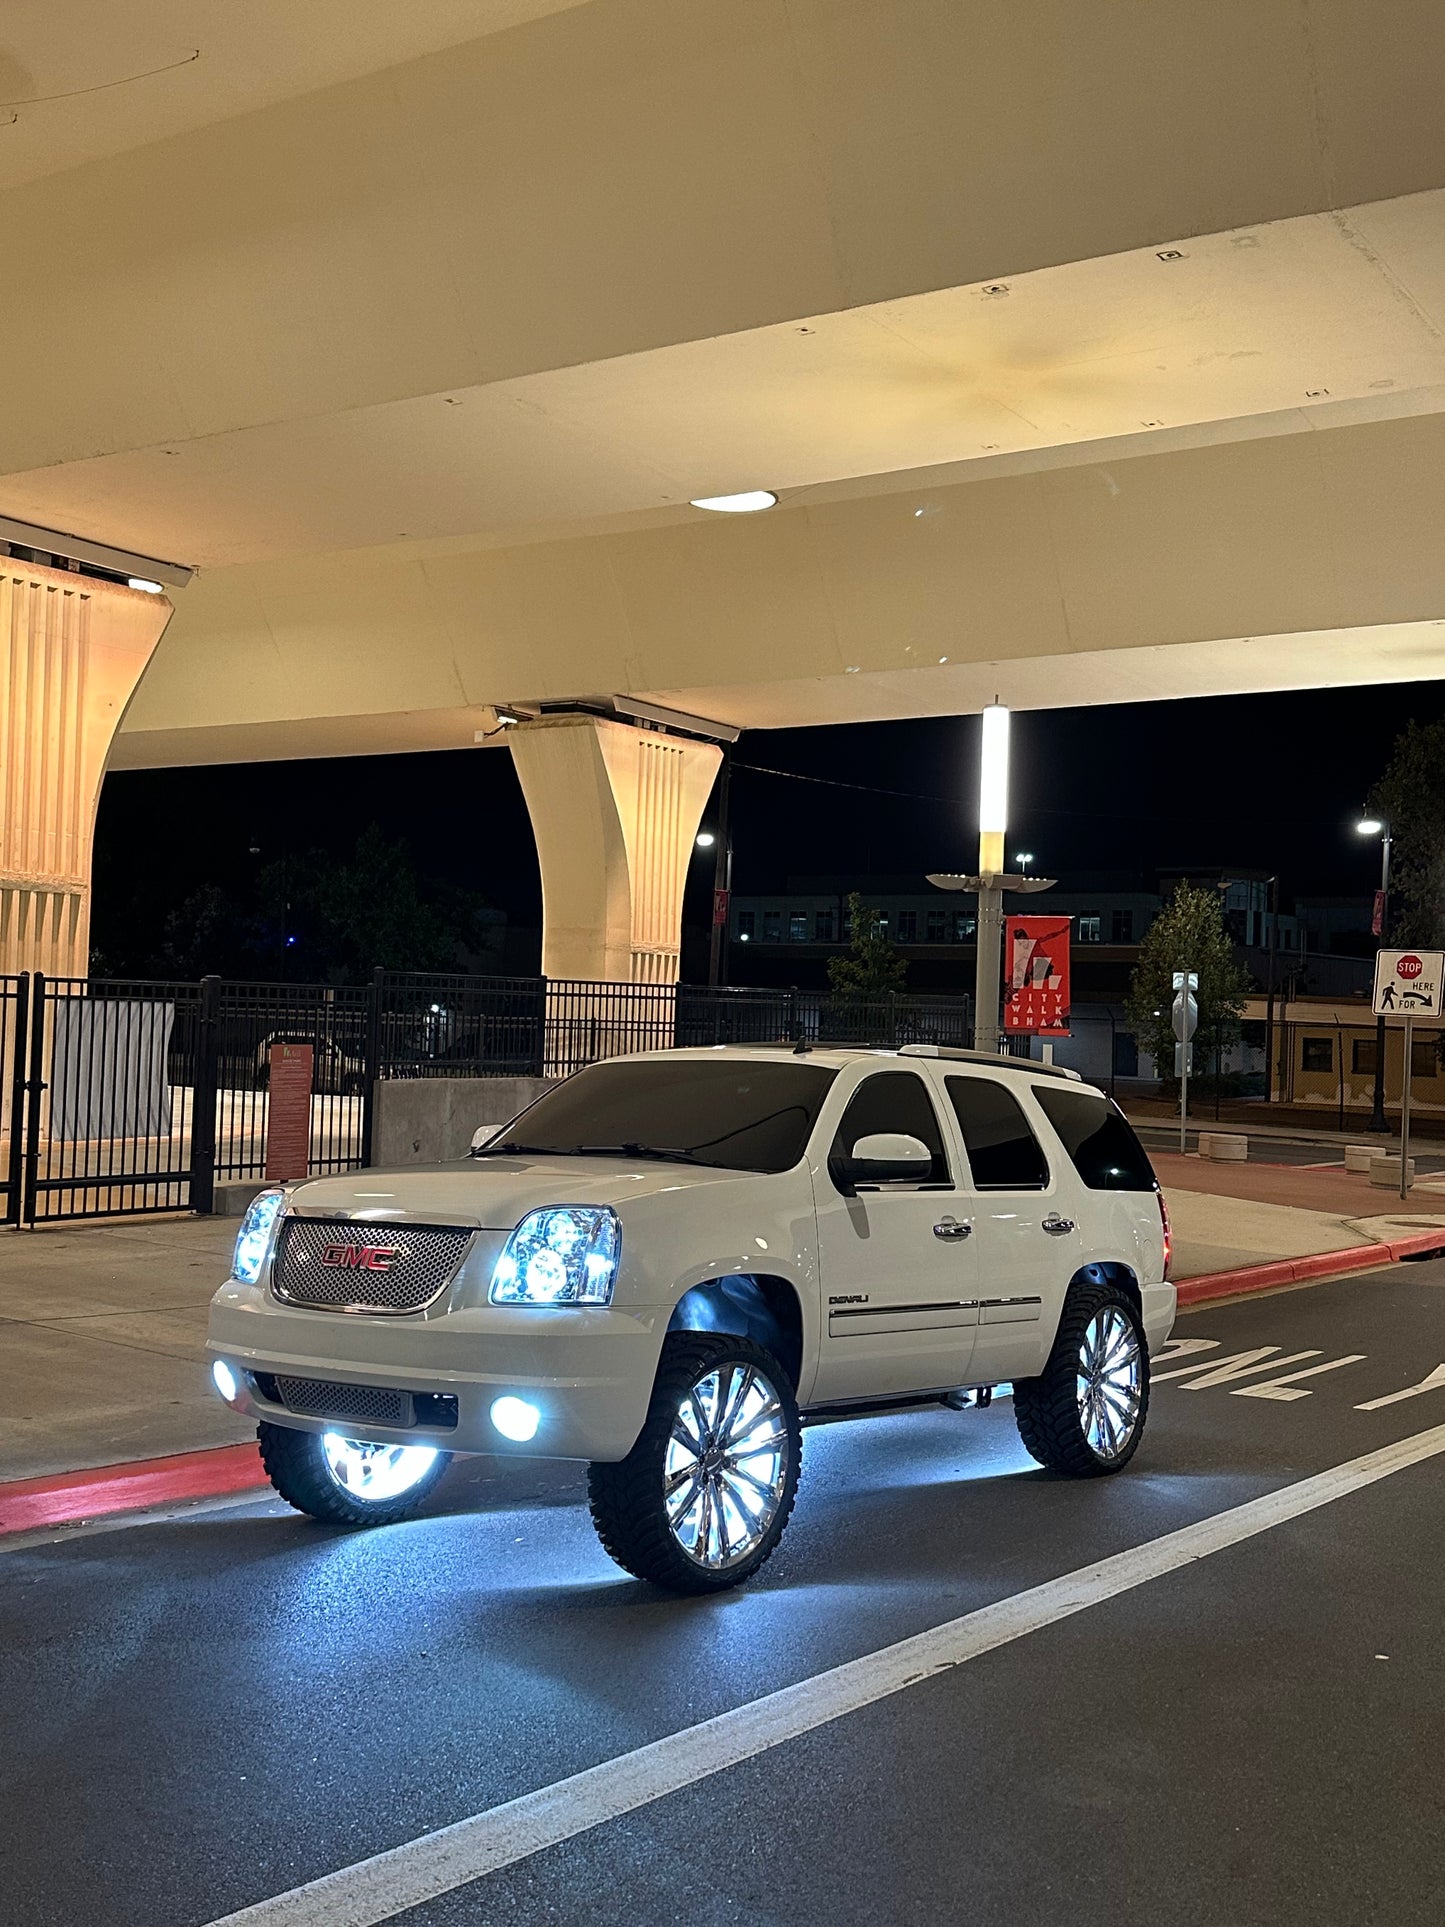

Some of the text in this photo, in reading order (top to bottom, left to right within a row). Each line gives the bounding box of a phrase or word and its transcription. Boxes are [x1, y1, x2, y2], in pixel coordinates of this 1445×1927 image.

[1398, 963, 1421, 972] STOP
[1412, 982, 1434, 991] HERE
[1012, 993, 1062, 1002] CITY
[1399, 1000, 1415, 1008] FOR
[1012, 1005, 1062, 1015] WALK
[1013, 1017, 1062, 1026] BHAM
[321, 1243, 395, 1271] GMC
[829, 1295, 868, 1304] DENALI
